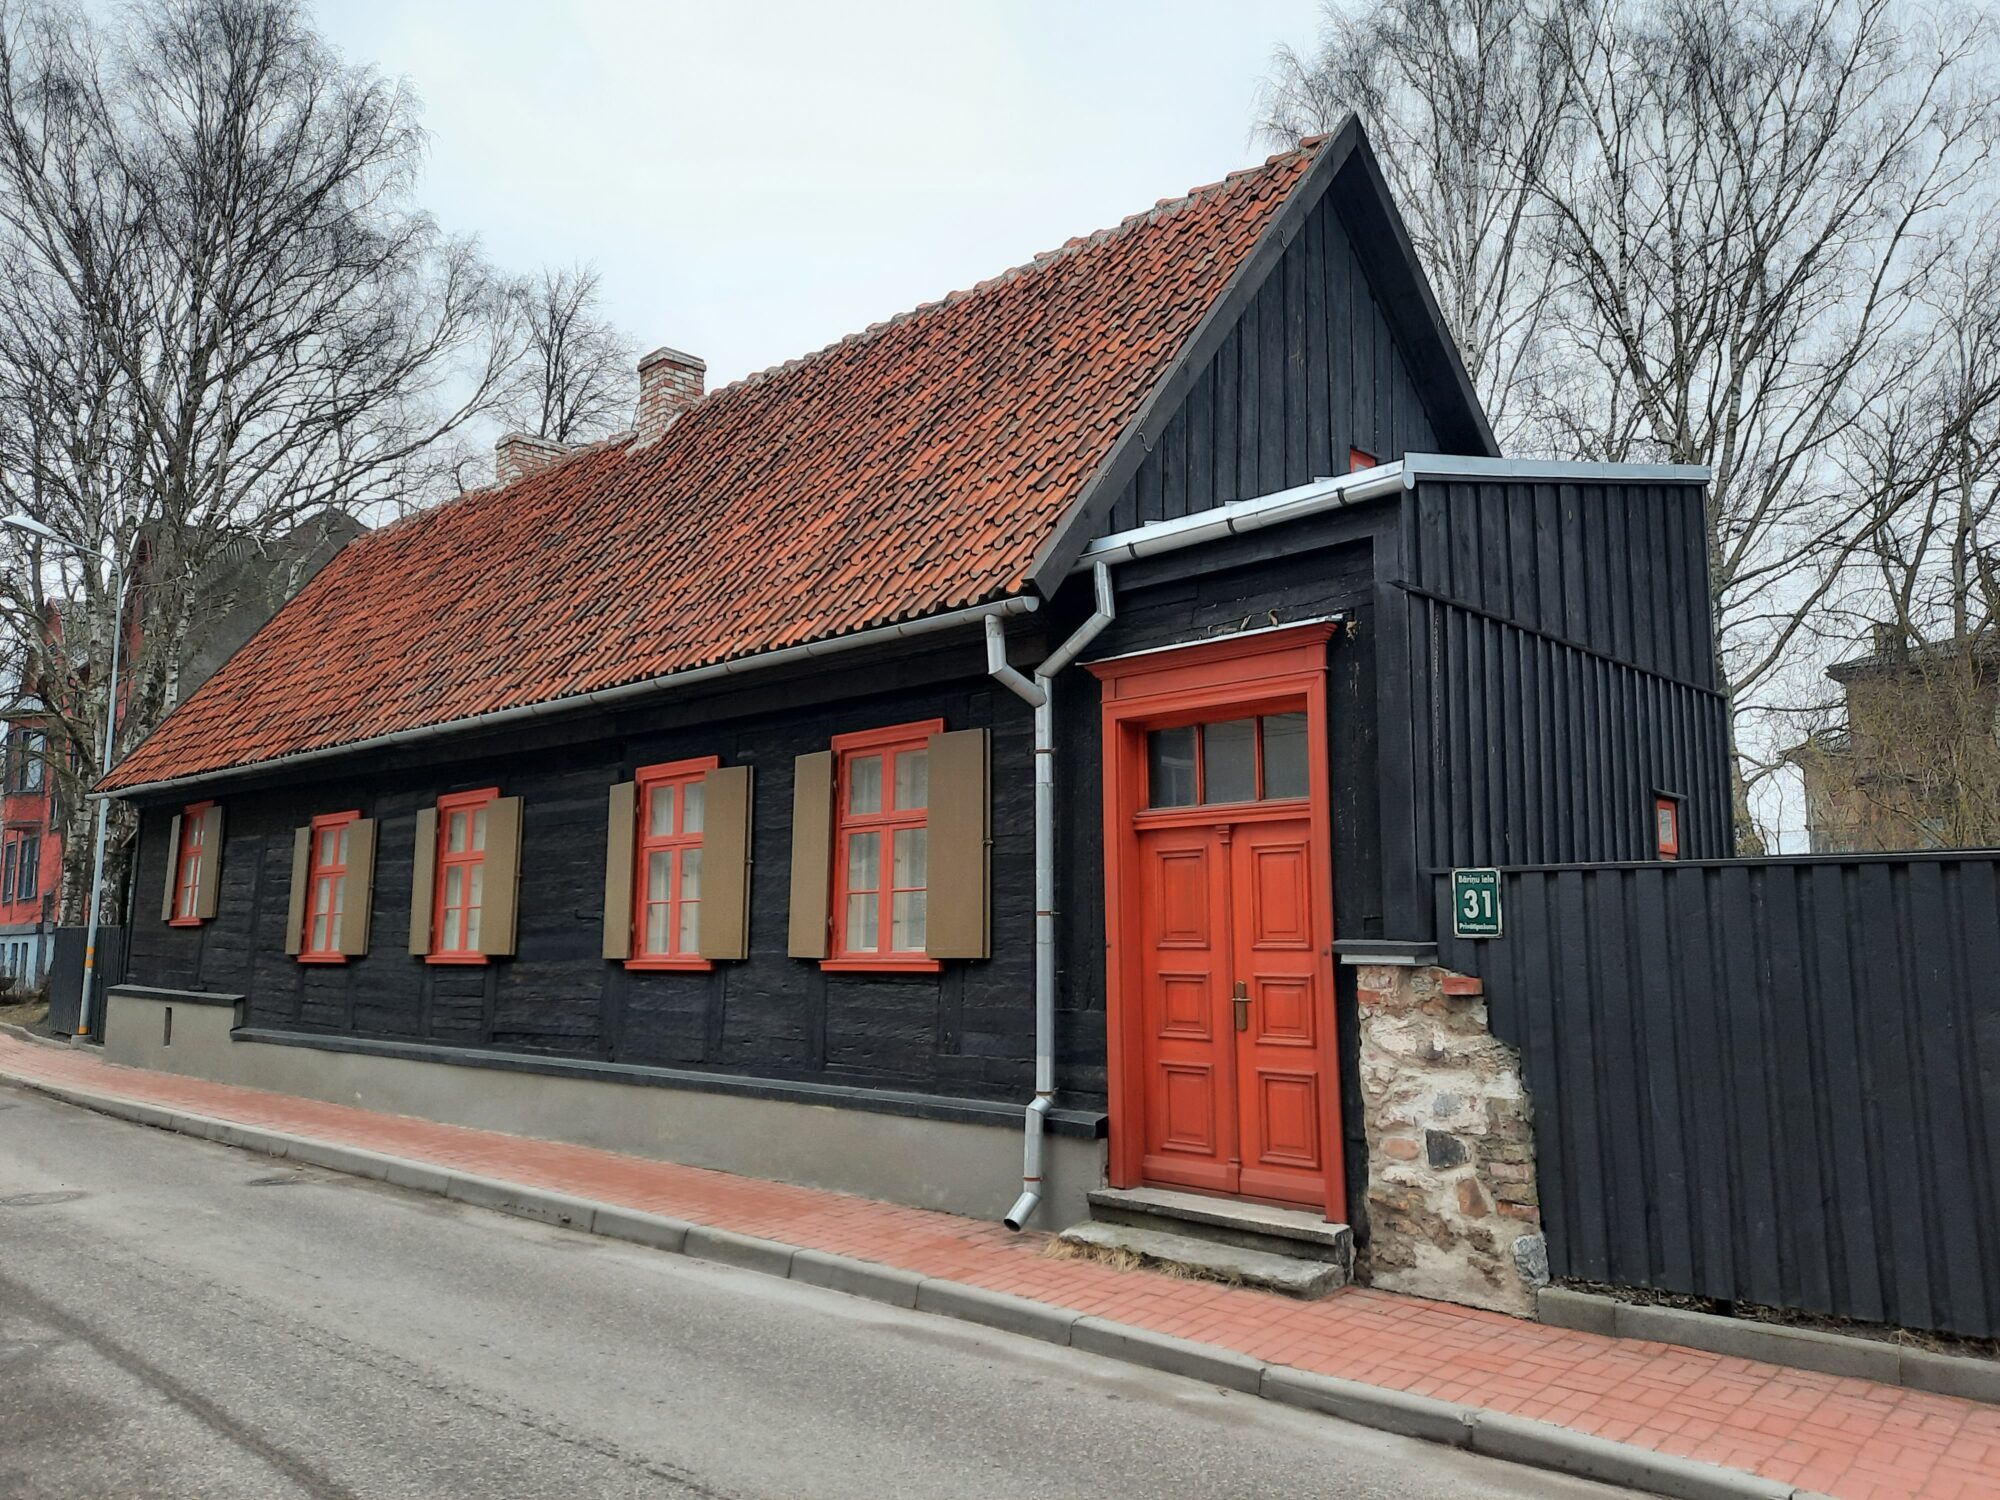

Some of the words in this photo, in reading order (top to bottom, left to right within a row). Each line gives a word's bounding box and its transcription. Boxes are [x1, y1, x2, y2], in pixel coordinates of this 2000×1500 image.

[1458, 874, 1480, 884] Bāriņu
[1481, 874, 1495, 883] iela
[1463, 889, 1492, 919] 31
